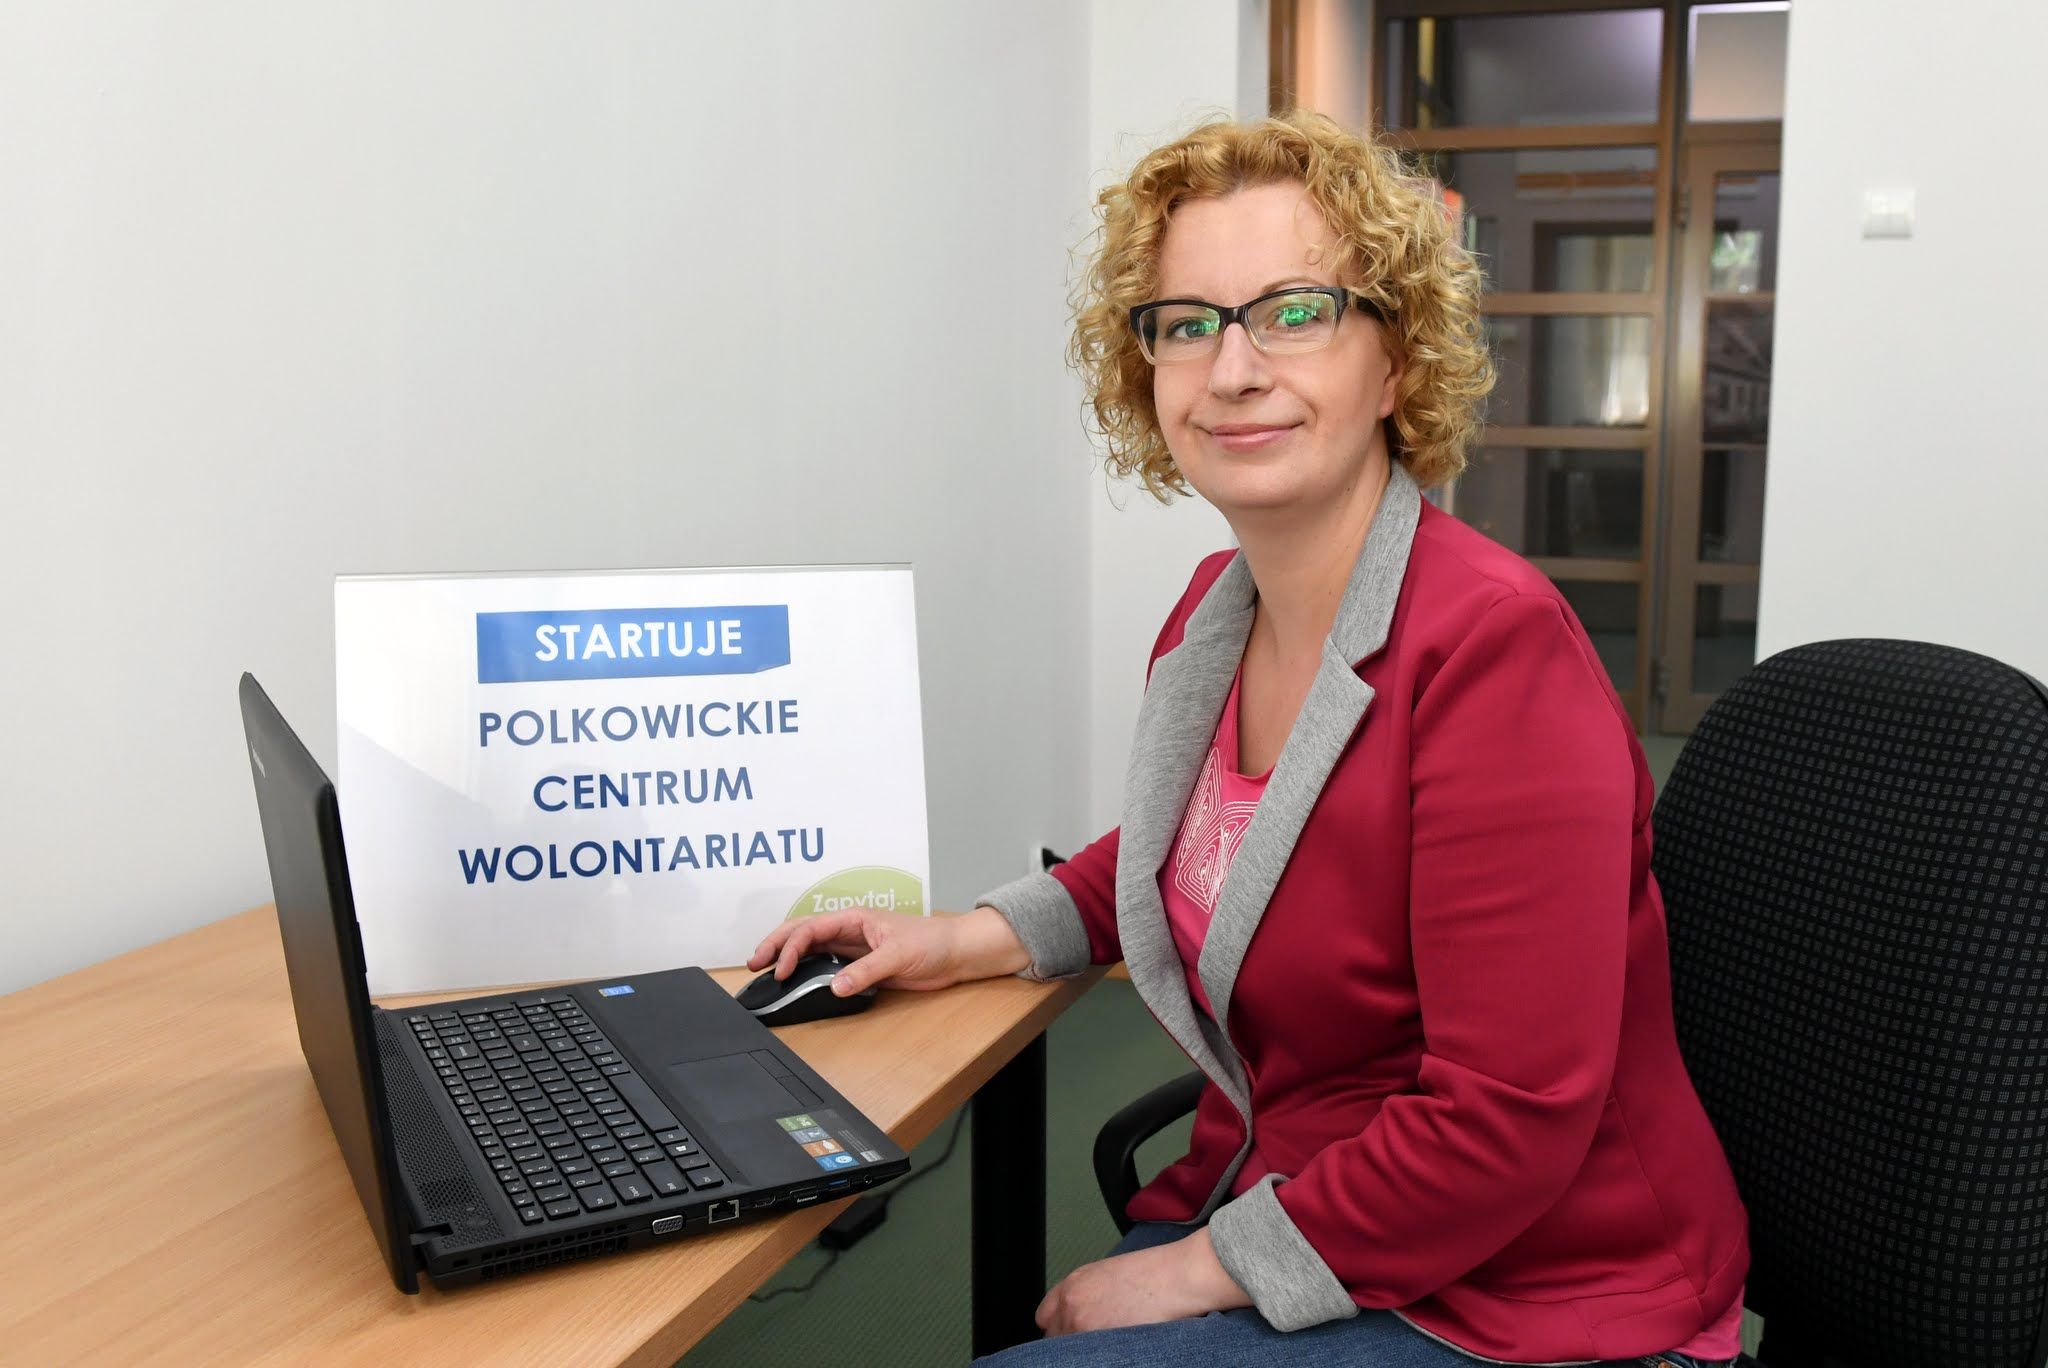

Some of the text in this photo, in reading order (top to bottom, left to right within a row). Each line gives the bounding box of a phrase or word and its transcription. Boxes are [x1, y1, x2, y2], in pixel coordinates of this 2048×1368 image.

[535, 619, 742, 662] STARTUJE
[479, 700, 798, 747] POLKOWICKIE
[533, 767, 753, 812] CENTRUM
[459, 828, 825, 885] WOLONTARIATU
